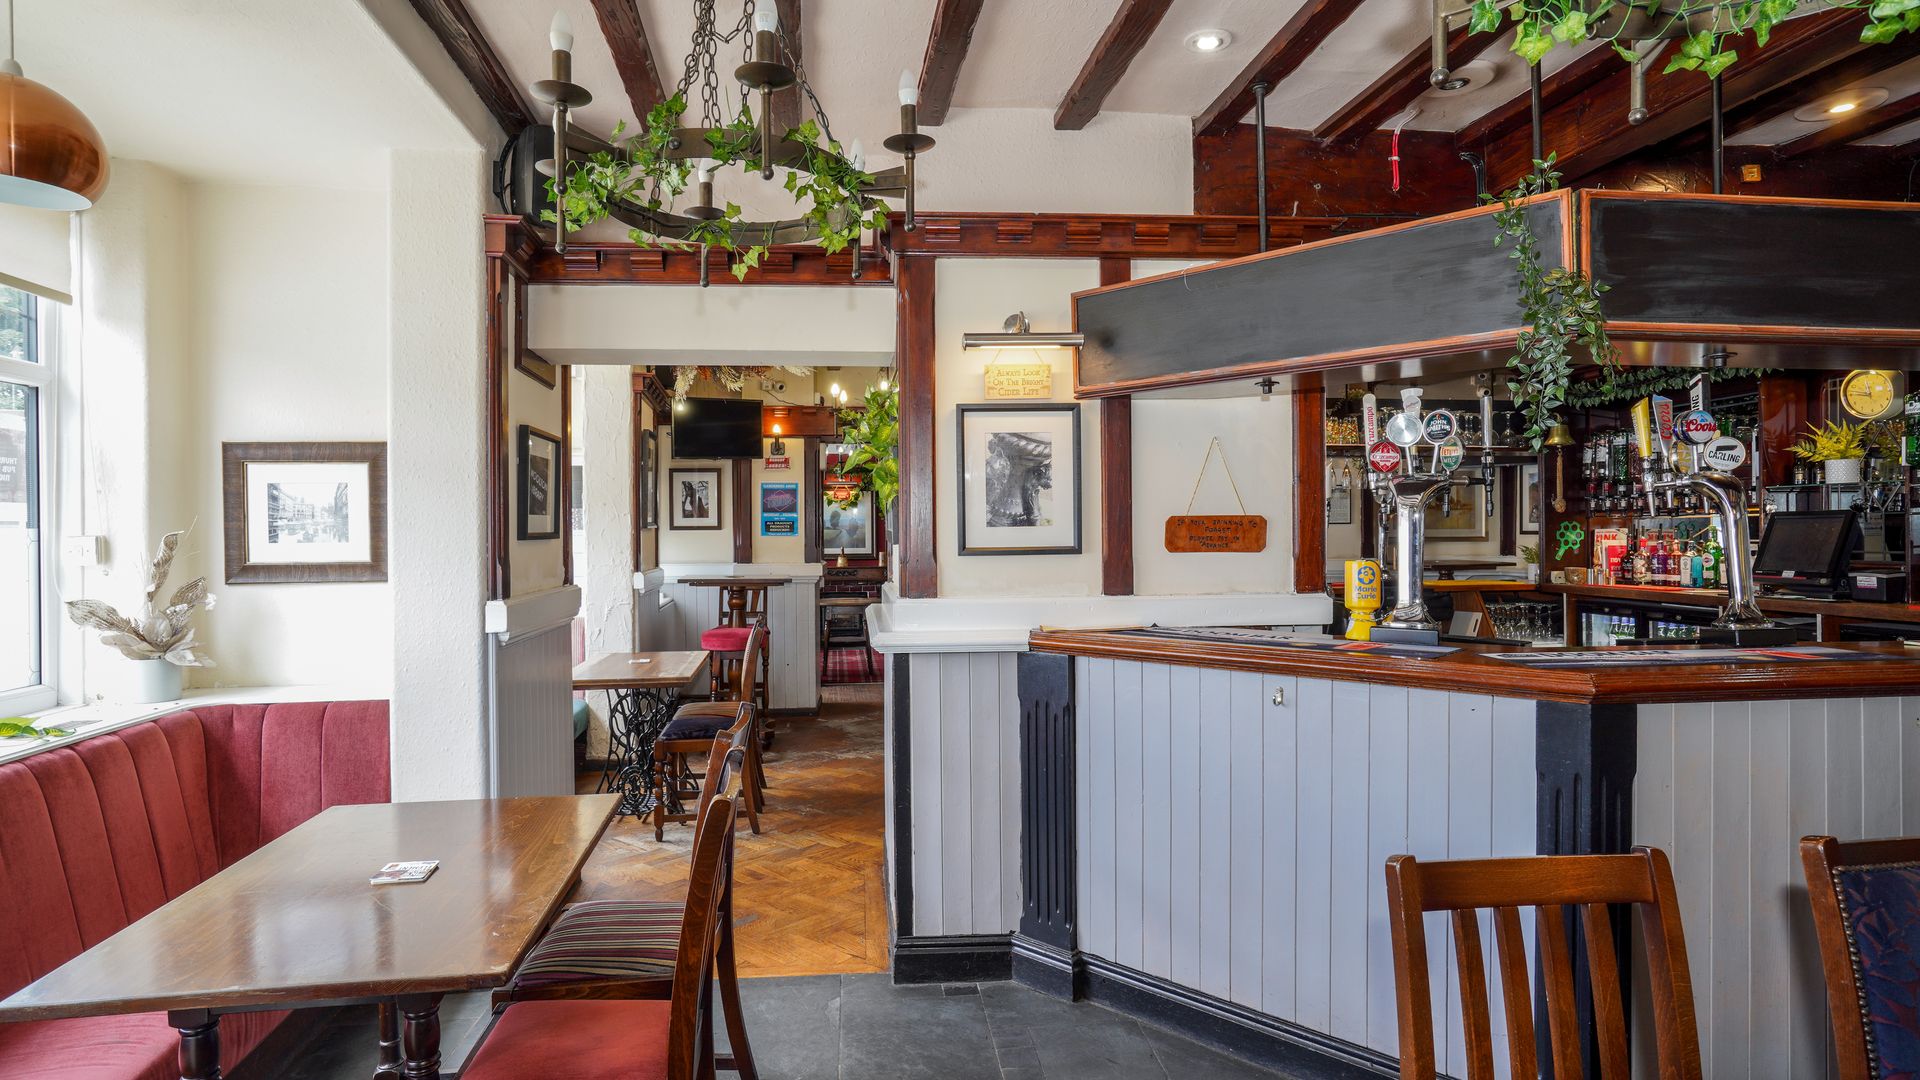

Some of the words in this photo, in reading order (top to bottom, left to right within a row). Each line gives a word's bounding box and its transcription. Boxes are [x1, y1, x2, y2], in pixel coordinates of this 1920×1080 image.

[1021, 378, 1044, 386] BRIGHT
[998, 388, 1020, 396] CIDER
[1023, 387, 1040, 396] LIFE
[1682, 418, 1716, 433] Coors
[1708, 450, 1741, 463] CARLING
[1249, 520, 1258, 528] TO
